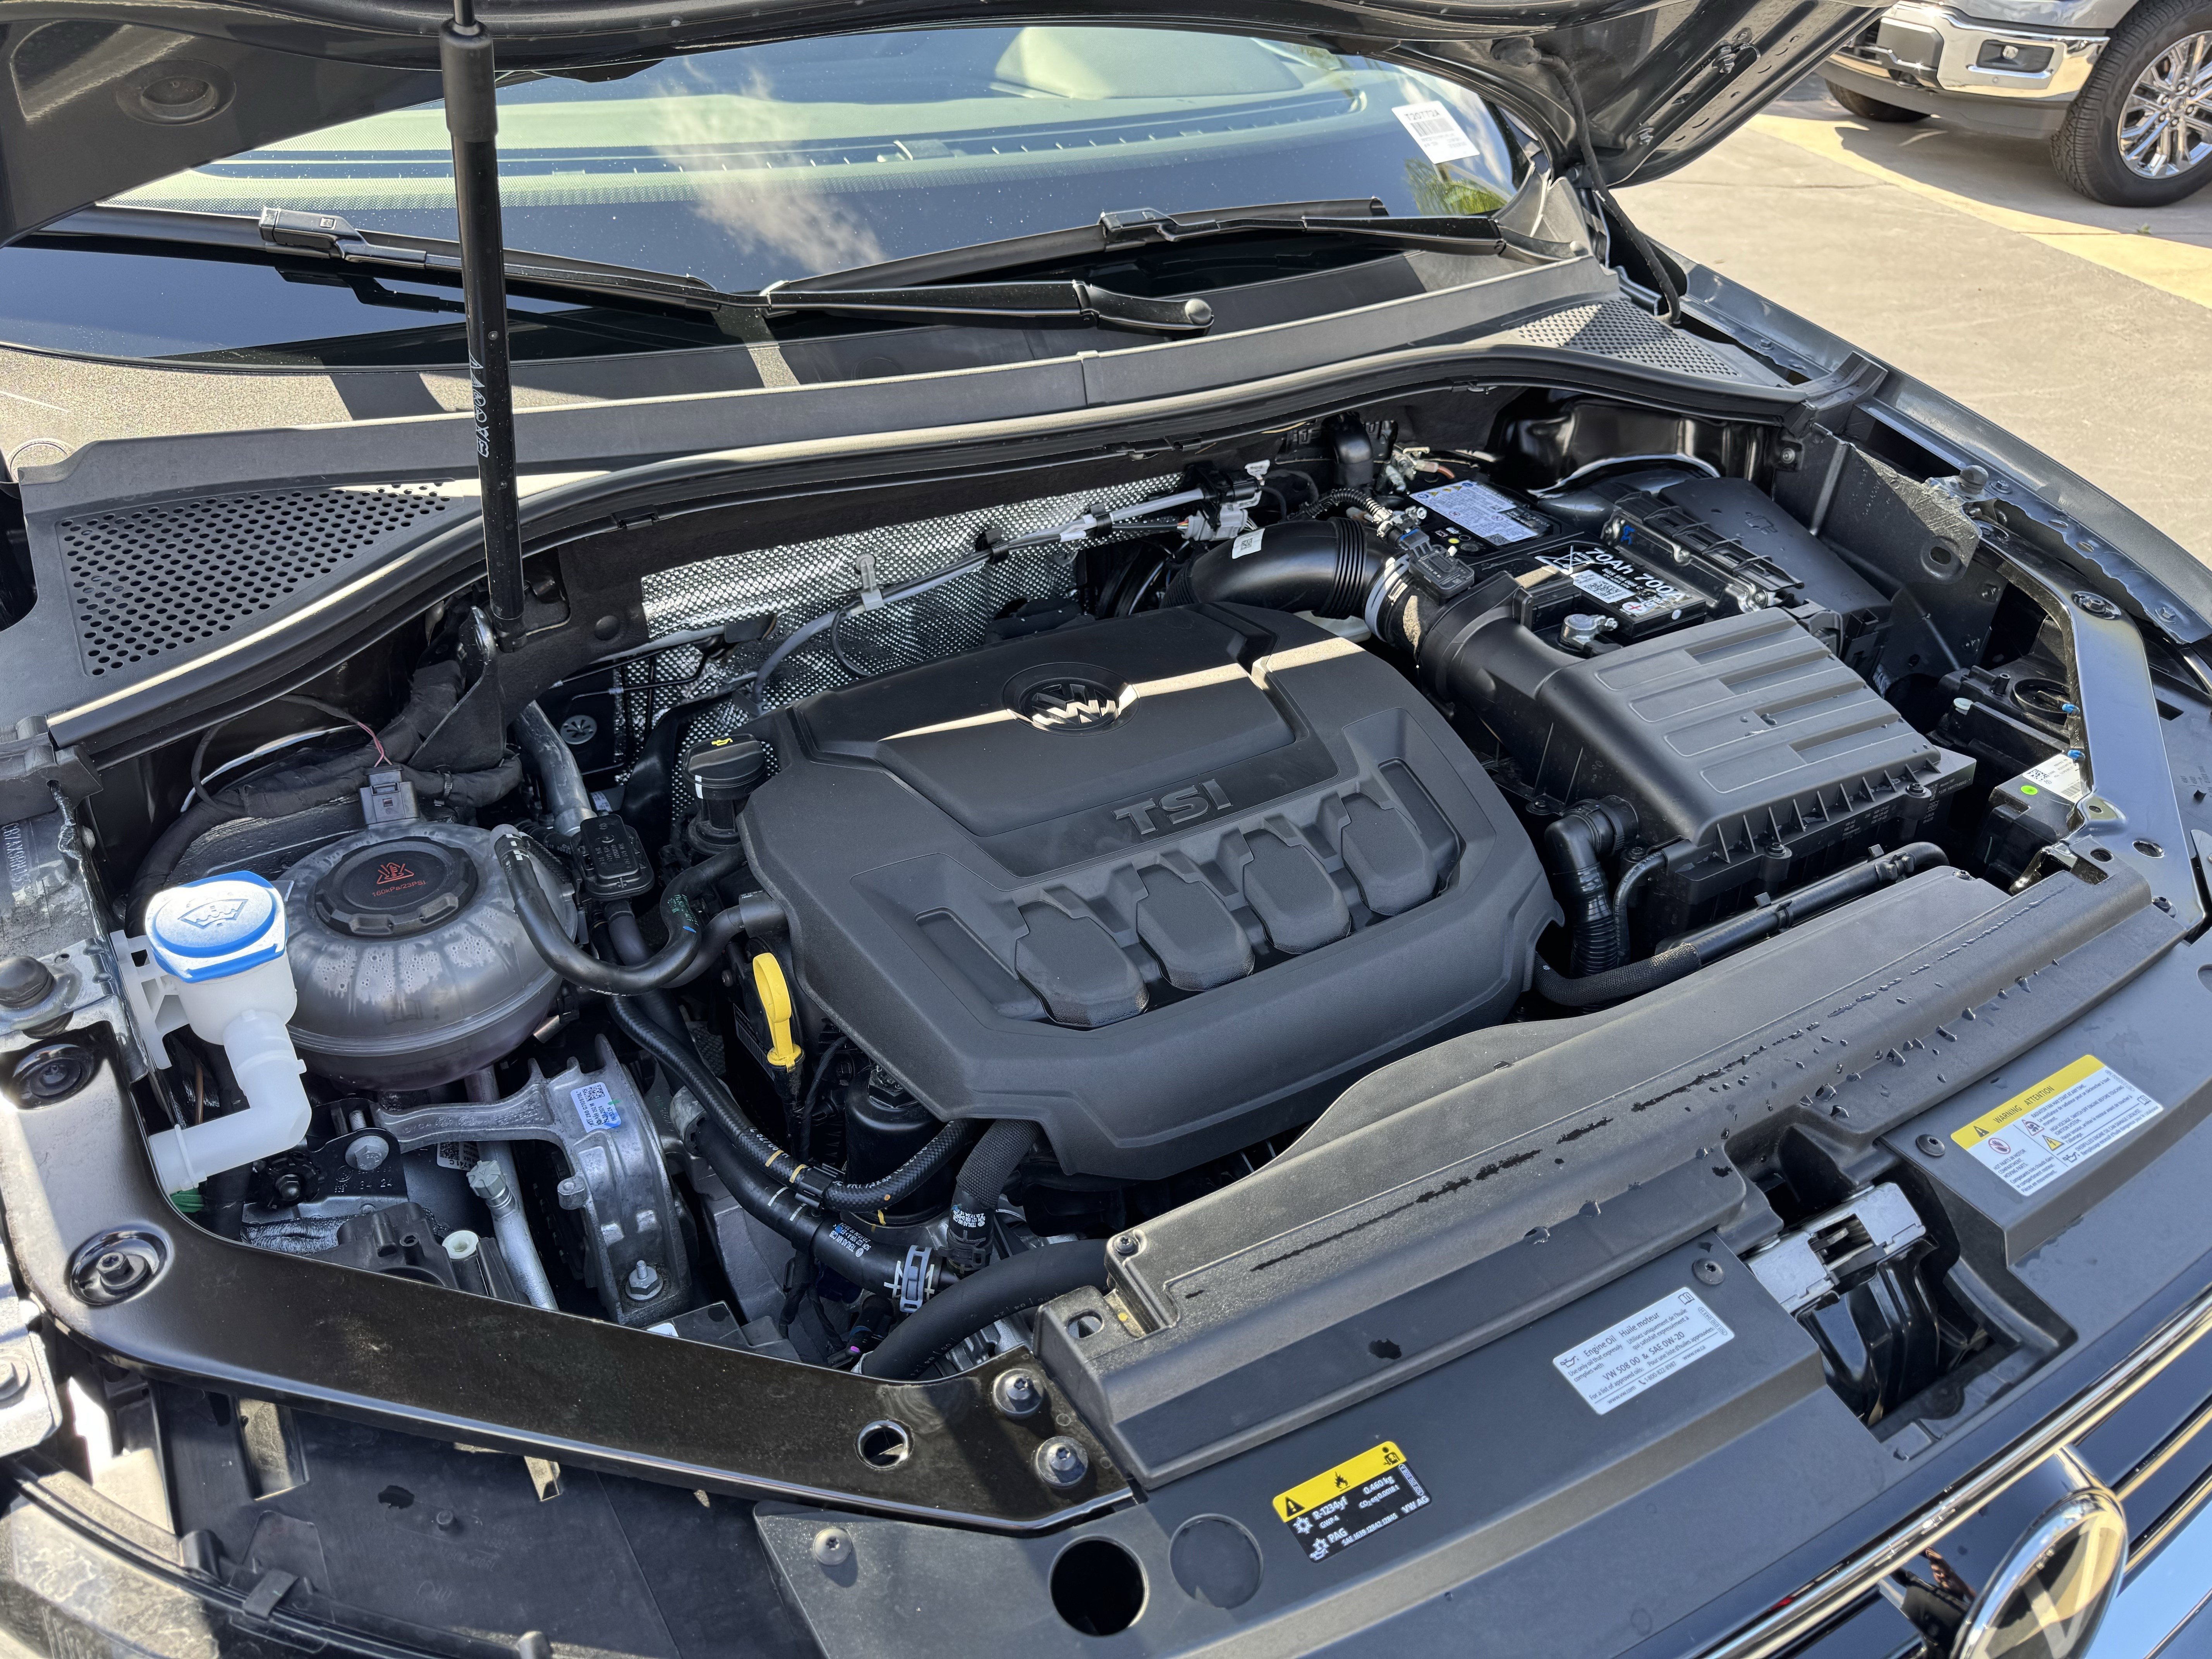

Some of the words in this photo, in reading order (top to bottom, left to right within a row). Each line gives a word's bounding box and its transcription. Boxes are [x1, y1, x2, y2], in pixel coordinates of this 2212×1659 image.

[1585, 547, 1634, 574] 70Ah
[1634, 573, 1686, 602] 700A
[1111, 779, 1233, 835] TSI
[1993, 1105, 2022, 1123] WARNING
[2024, 1086, 2054, 1105] ATTENTION
[2098, 1094, 2110, 1102] BEFORE
[2031, 1107, 2047, 1118] RADIATOR
[2013, 1149, 2026, 1157] MOTOR
[2003, 1168, 2018, 1178] MOVING
[1583, 1342, 1606, 1357] Engine
[1605, 1335, 1616, 1344] Oil
[1618, 1325, 1637, 1336] Huile
[1637, 1313, 1659, 1328] moteur
[1626, 1333, 1644, 1344] Utilisez
[1643, 1319, 1669, 1335] uniquement
[1673, 1309, 1687, 1317] l'huile
[1640, 1333, 1657, 1345] satisfait
[1657, 1317, 1685, 1336] expressément
[1602, 1344, 1623, 1357] expressly
[1647, 1358, 1658, 1366] Pour
[1675, 1340, 1691, 1351] d'huiles
[1691, 1327, 1714, 1342] approuvées:
[1602, 1369, 1616, 1380] VW
[1616, 1362, 1630, 1373] 508
[1629, 1357, 1640, 1365] 00
[1649, 1343, 1663, 1354] SAE
[1662, 1331, 1684, 1346] 0W-20
[1574, 1369, 1593, 1382] complies
[1607, 1386, 1635, 1403] www.vw.com
[1644, 1361, 1676, 1381] 1-800-822-8987
[1683, 1345, 1705, 1360] www.vw.ca
[1614, 1371, 1634, 1386] approved
[1363, 1480, 1383, 1494] 0.460
[1382, 1476, 1395, 1484] kg
[1312, 1496, 1347, 1519] R-1234yf
[1401, 1501, 1416, 1512] VW
[1417, 1496, 1429, 1506] AG
[1320, 1517, 1333, 1528] GWP
[1328, 1528, 1347, 1542] PAG
[1342, 1535, 1353, 1546] SAE
